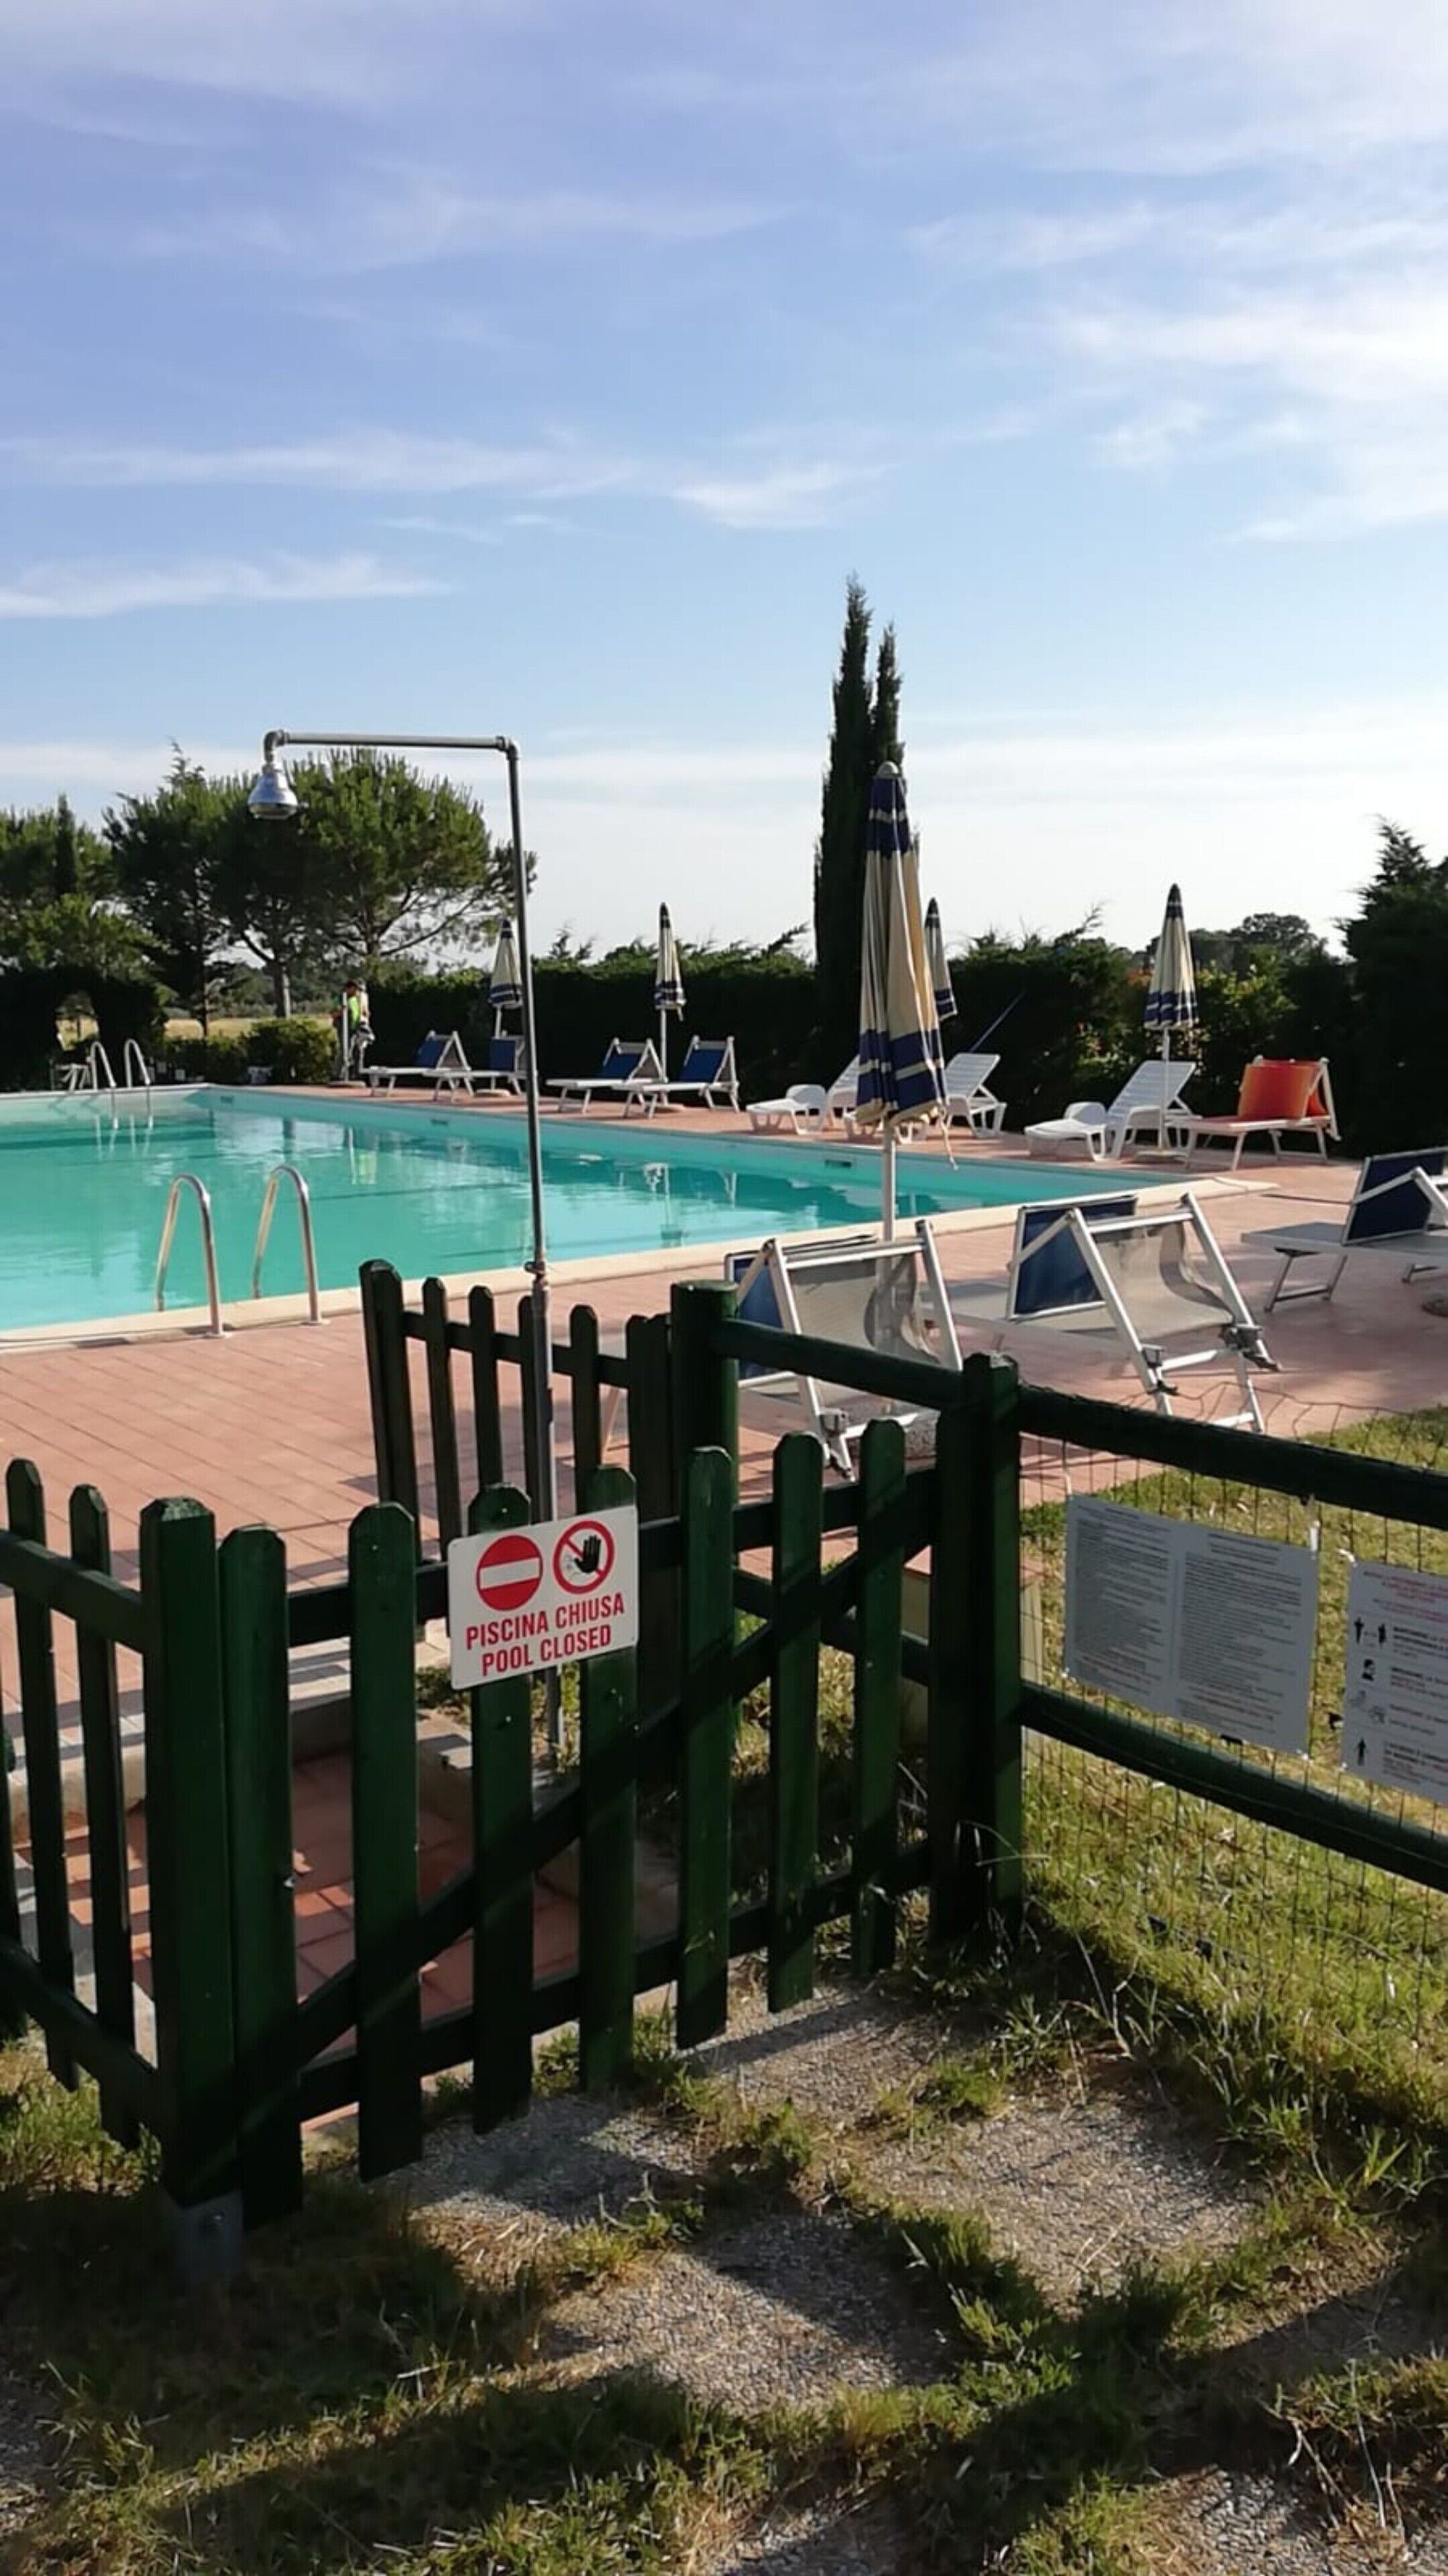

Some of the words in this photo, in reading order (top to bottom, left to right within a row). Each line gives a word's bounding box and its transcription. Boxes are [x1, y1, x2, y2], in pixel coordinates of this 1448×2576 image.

[465, 1611, 549, 1650] PISCINA
[555, 1592, 624, 1629] CHIUSA
[482, 1646, 533, 1676] POOL
[540, 1624, 611, 1662] CLOSED
